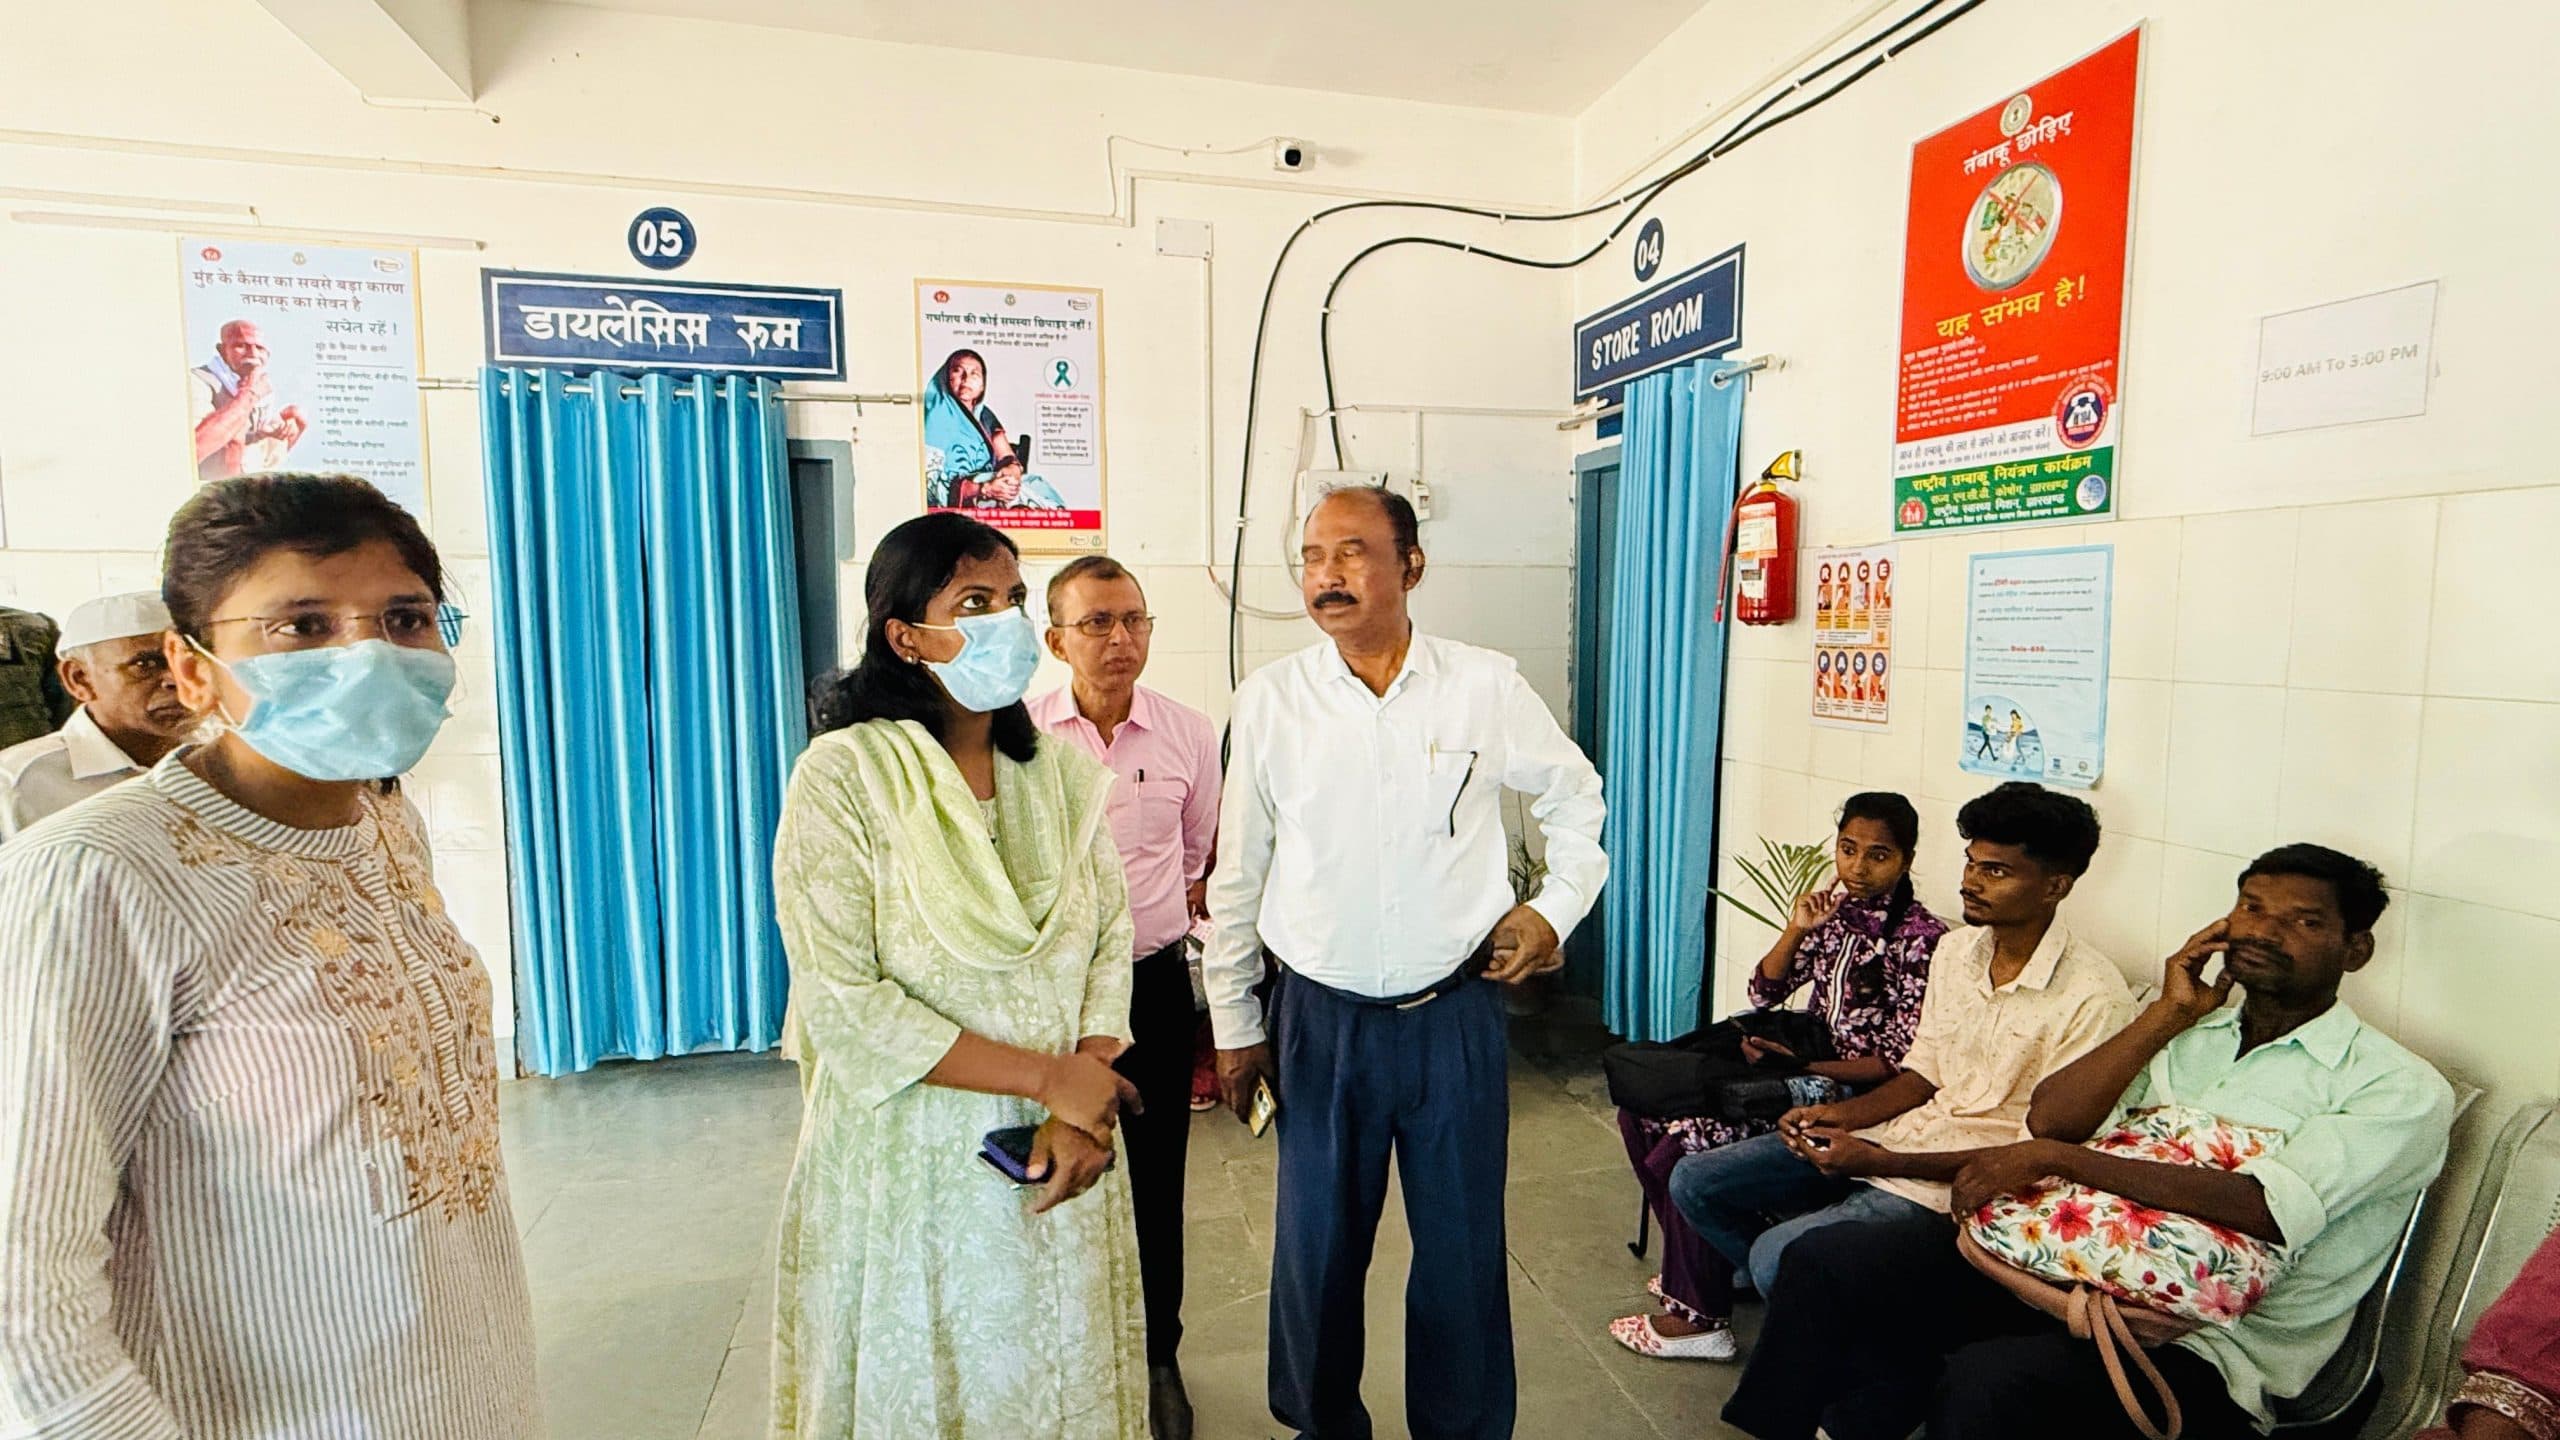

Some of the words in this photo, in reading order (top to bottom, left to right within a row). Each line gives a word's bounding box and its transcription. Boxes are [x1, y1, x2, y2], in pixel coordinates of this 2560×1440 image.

[1963, 140, 2012, 176] तंबाकू
[2015, 111, 2074, 152] छोड़िए
[636, 220, 684, 257] 05
[1637, 231, 1660, 271] 04
[217, 268, 232, 284] के
[274, 276, 293, 288] का
[298, 275, 332, 290] सबसे
[366, 281, 405, 295] कारण
[240, 292, 289, 312] तम्बाकू
[293, 297, 311, 309] का
[316, 293, 348, 311] सेवन
[351, 296, 363, 312] है
[963, 312, 977, 324] की
[980, 312, 998, 327] कोई
[1936, 312, 1972, 338] यह
[1980, 291, 2044, 326] संभव
[326, 319, 363, 334] सचेत
[518, 294, 712, 354] डायलेसिस
[1591, 320, 1641, 371] STORE
[1650, 292, 1704, 348] ROOM
[2261, 365, 2292, 383] 9:00
[2294, 361, 2321, 378] AM
[2326, 357, 2345, 371] To
[2350, 350, 2385, 368] 3:00
[2390, 344, 2418, 361] PM
[1912, 474, 1947, 493] राष्ट्रीय
[1994, 463, 2038, 481] नियंत्रण
[2044, 455, 2093, 474] कार्यक्रम
